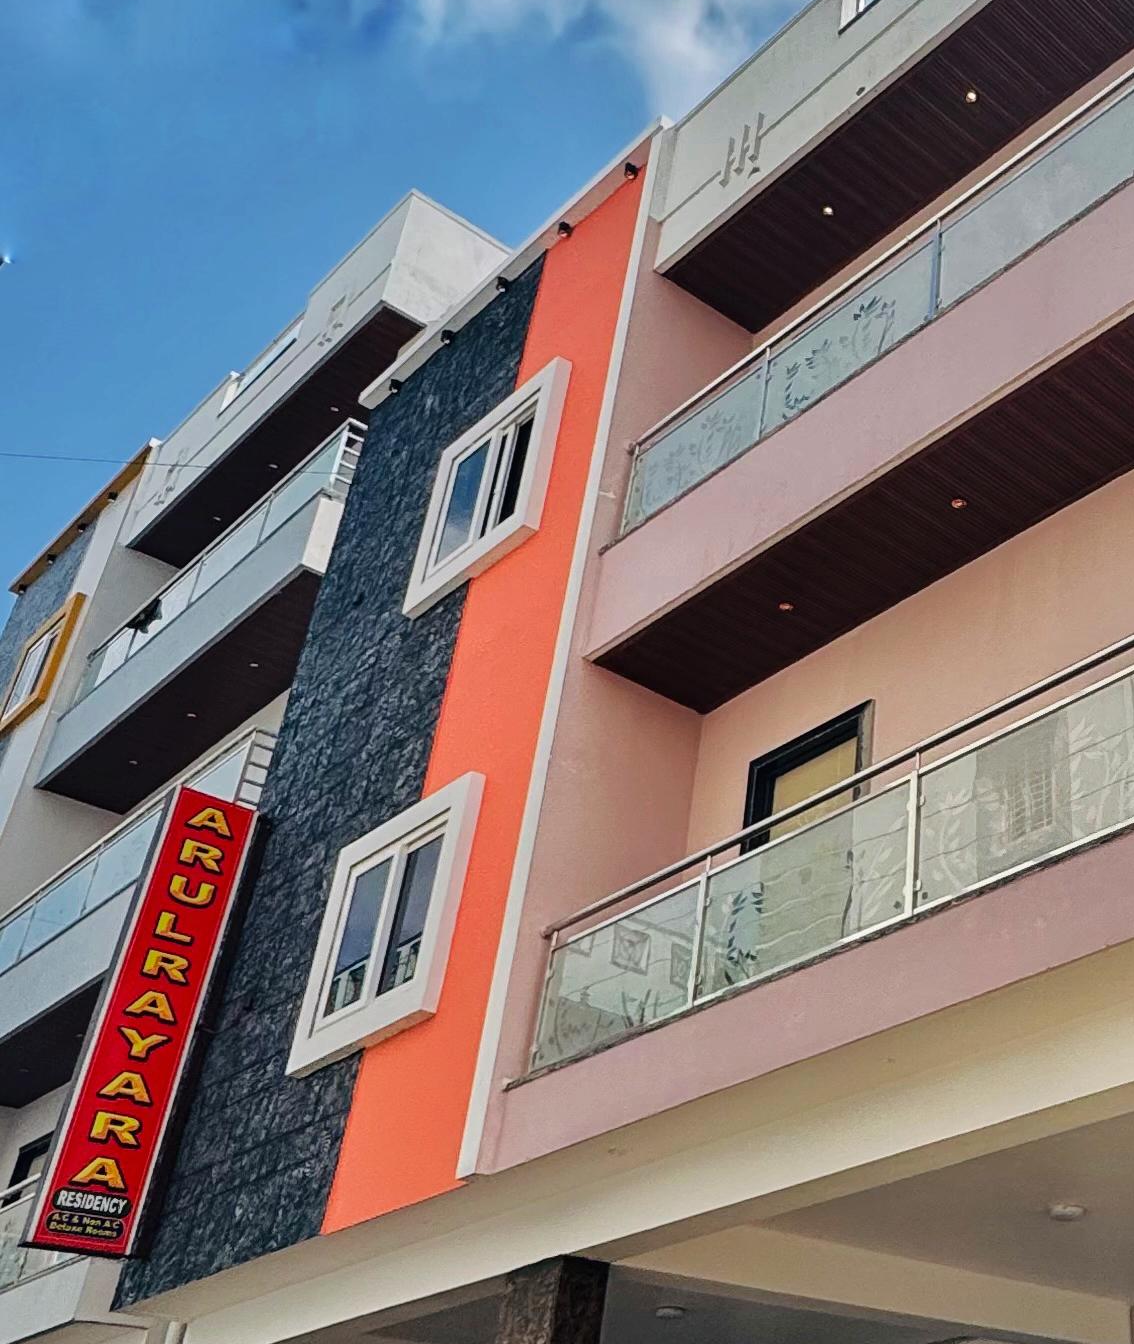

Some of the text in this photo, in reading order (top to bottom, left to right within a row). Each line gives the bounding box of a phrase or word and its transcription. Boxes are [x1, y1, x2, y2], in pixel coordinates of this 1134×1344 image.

[69, 807, 231, 1189] ARULRAYARA
[57, 1190, 127, 1214] RESIDENCY
[82, 1216, 101, 1226] Non
